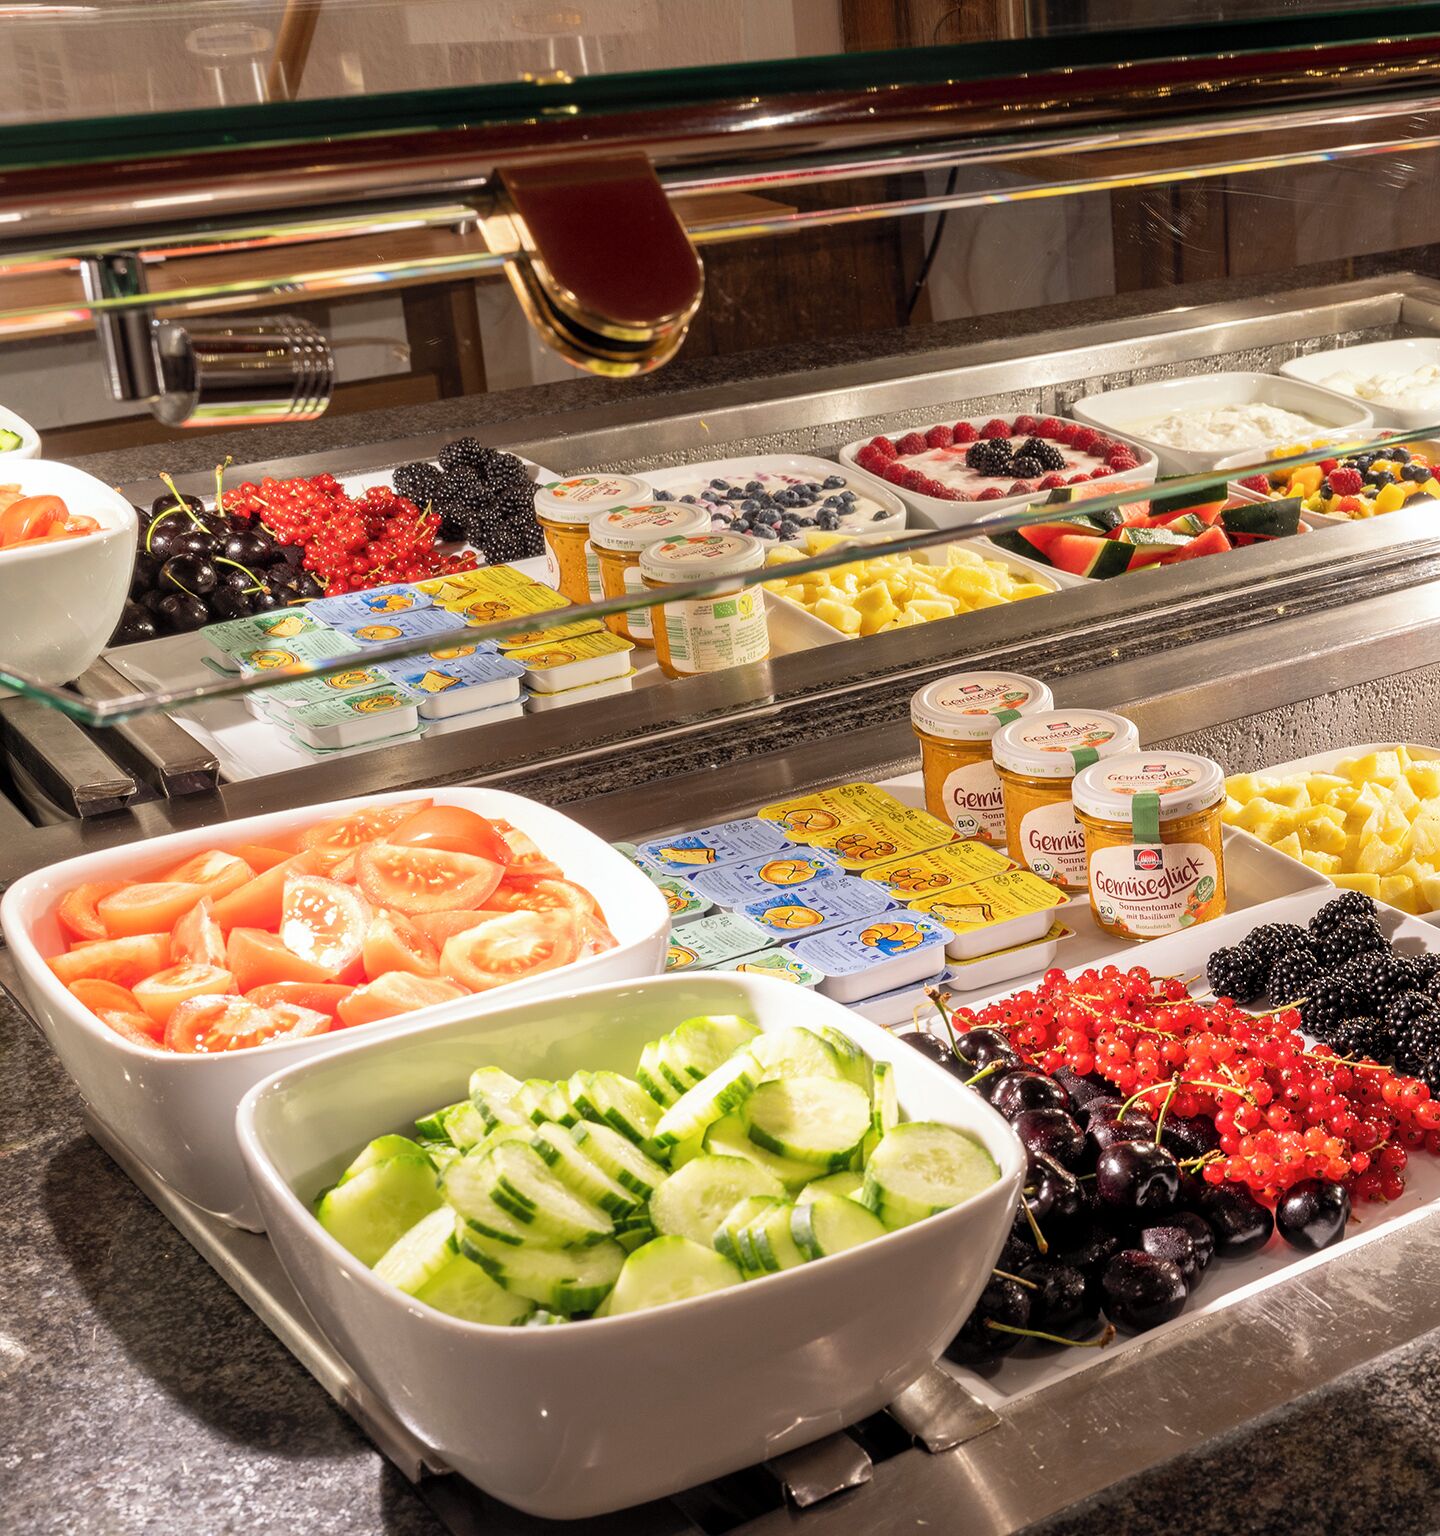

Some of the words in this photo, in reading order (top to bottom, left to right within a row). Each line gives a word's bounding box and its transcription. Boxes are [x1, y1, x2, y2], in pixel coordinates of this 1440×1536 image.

[1025, 764, 1045, 773] Vegan
[953, 786, 1003, 808] Gemü
[1109, 809, 1130, 817] Vegan
[1095, 856, 1204, 900] Gemüseglück
[1118, 901, 1183, 912] Sonnentomate
[1126, 912, 1138, 920] mit
[1139, 912, 1176, 920] Basilikum
